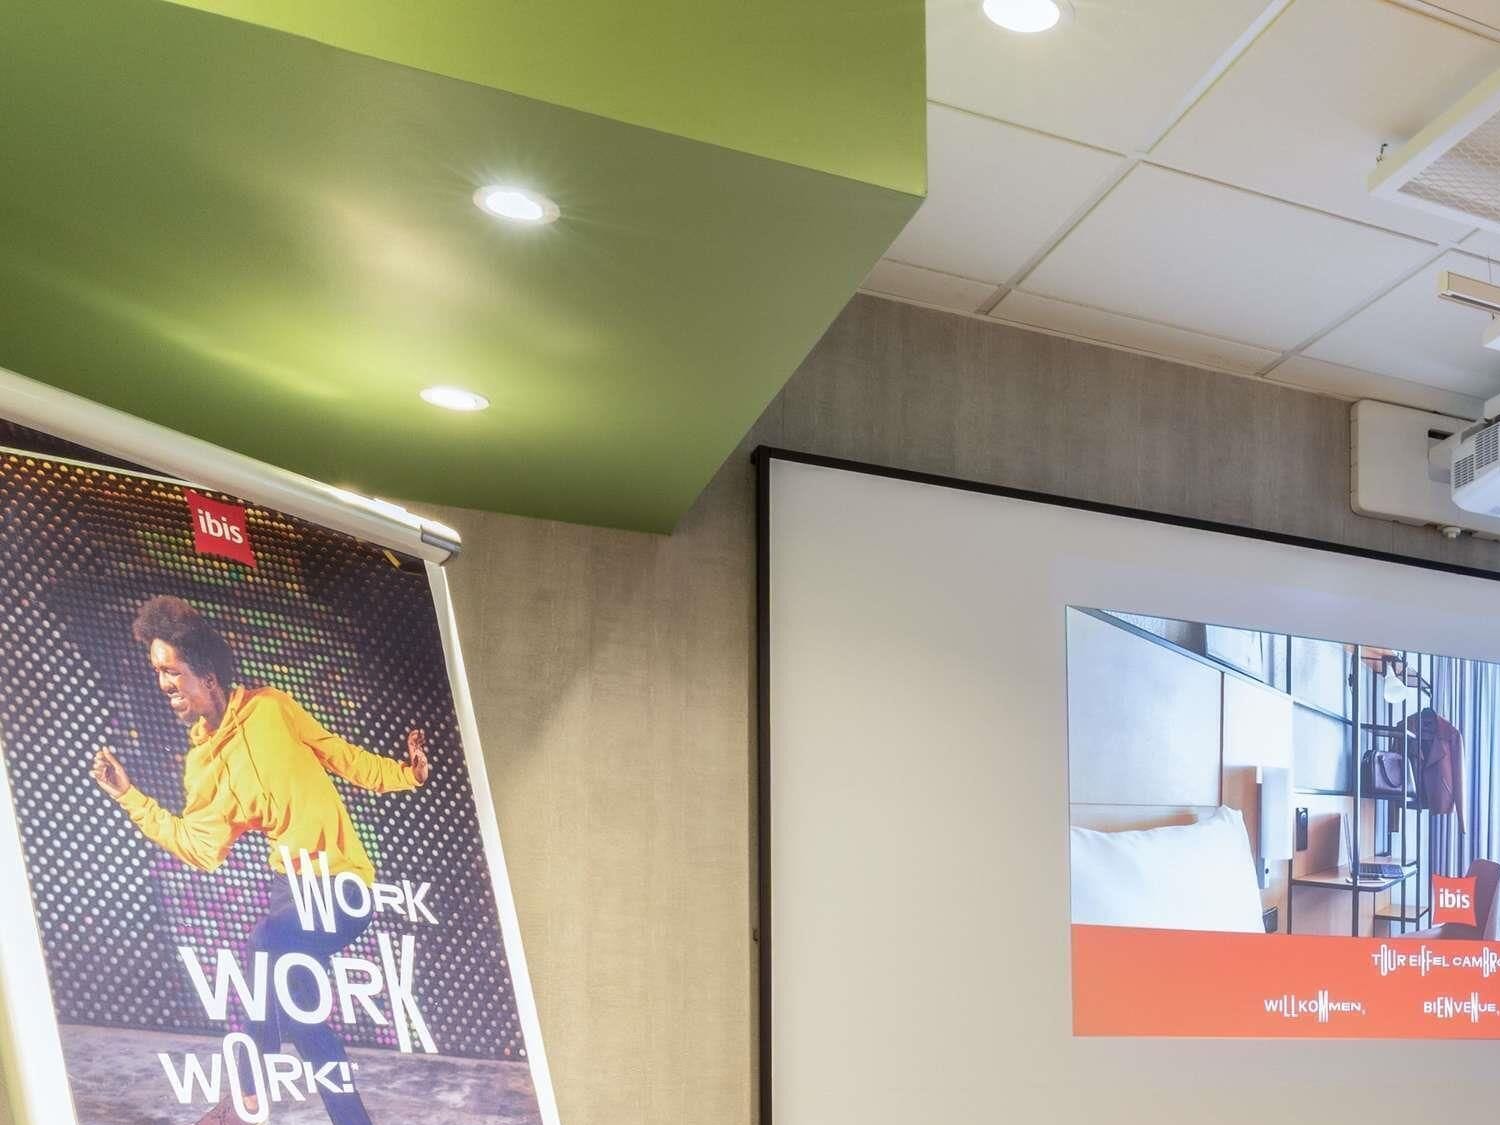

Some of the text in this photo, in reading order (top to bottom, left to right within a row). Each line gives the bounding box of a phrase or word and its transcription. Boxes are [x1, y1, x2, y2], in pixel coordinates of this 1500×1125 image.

[197, 508, 244, 544] ibis
[278, 844, 440, 934] WORK
[1439, 887, 1471, 909] ibis
[1372, 944, 1407, 976] TOUR
[1409, 945, 1450, 976] EIFFEL
[177, 932, 440, 1054] WORK
[1263, 990, 1366, 1023] WILLKOMMEN,
[1423, 992, 1500, 1023] BIENVENUE,
